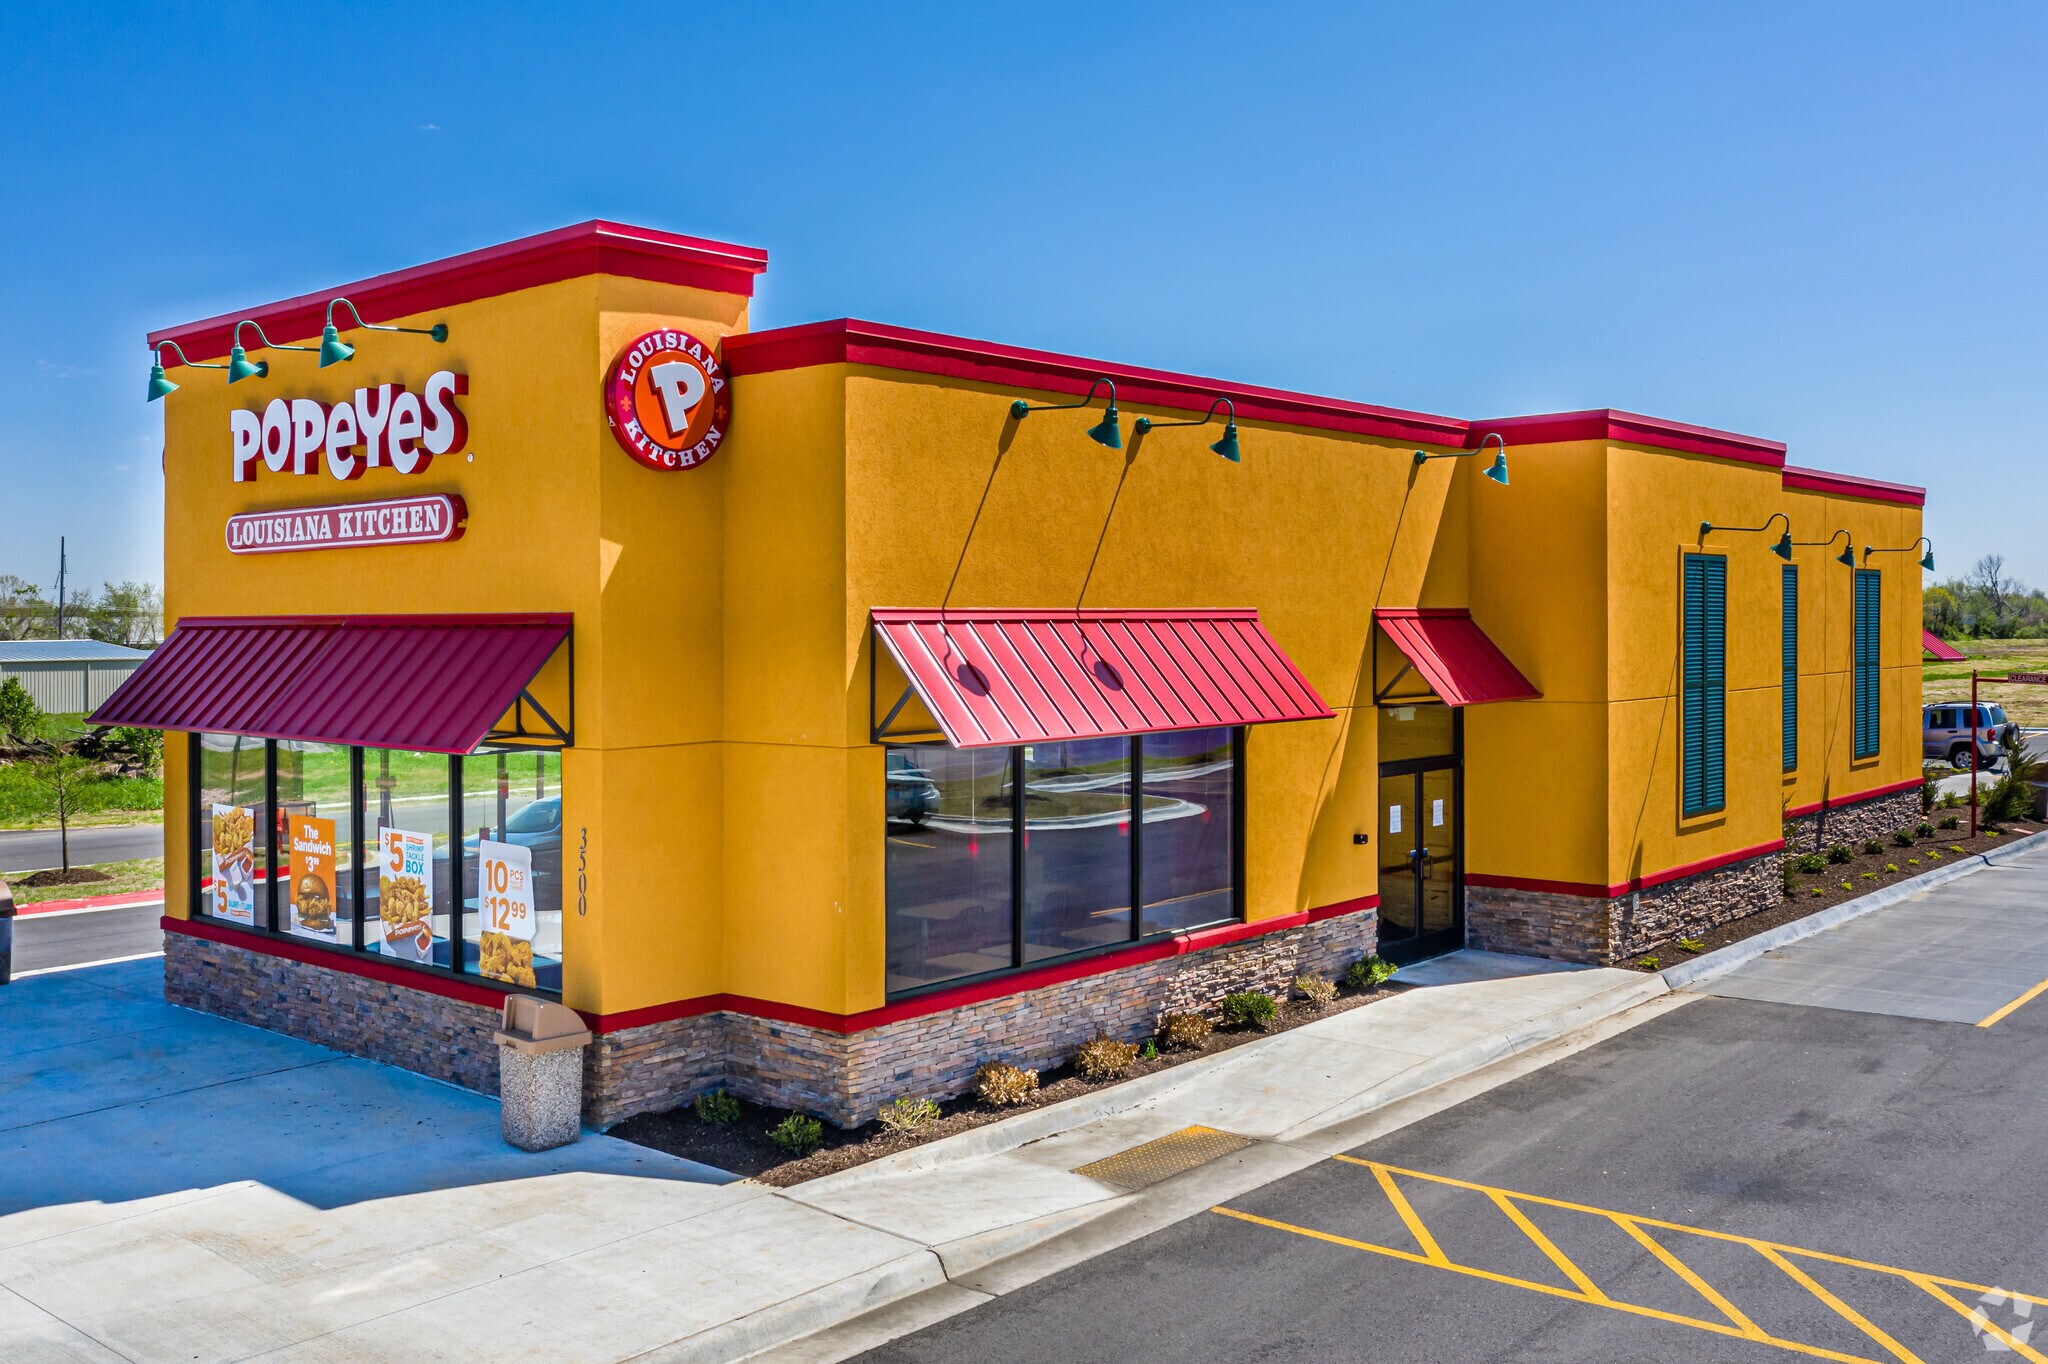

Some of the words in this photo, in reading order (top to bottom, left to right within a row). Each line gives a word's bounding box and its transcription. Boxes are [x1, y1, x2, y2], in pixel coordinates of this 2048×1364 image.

[620, 333, 725, 393] LOUISIANA
[649, 361, 706, 436] P
[624, 417, 722, 467] KITCHEN
[231, 514, 332, 546] LOUISIANA
[338, 504, 441, 538] KITCHEN
[2010, 674, 2047, 683] CLEARANCE
[293, 836, 332, 856] Sandwich
[303, 824, 319, 840] The
[405, 843, 425, 853] SHRIMP
[384, 832, 404, 872] $5
[405, 851, 425, 861] TACKLE
[405, 860, 425, 875] BOX
[485, 859, 508, 894] 10
[509, 869, 524, 881] PCS
[578, 827, 587, 917] 3500
[213, 879, 228, 914] $5
